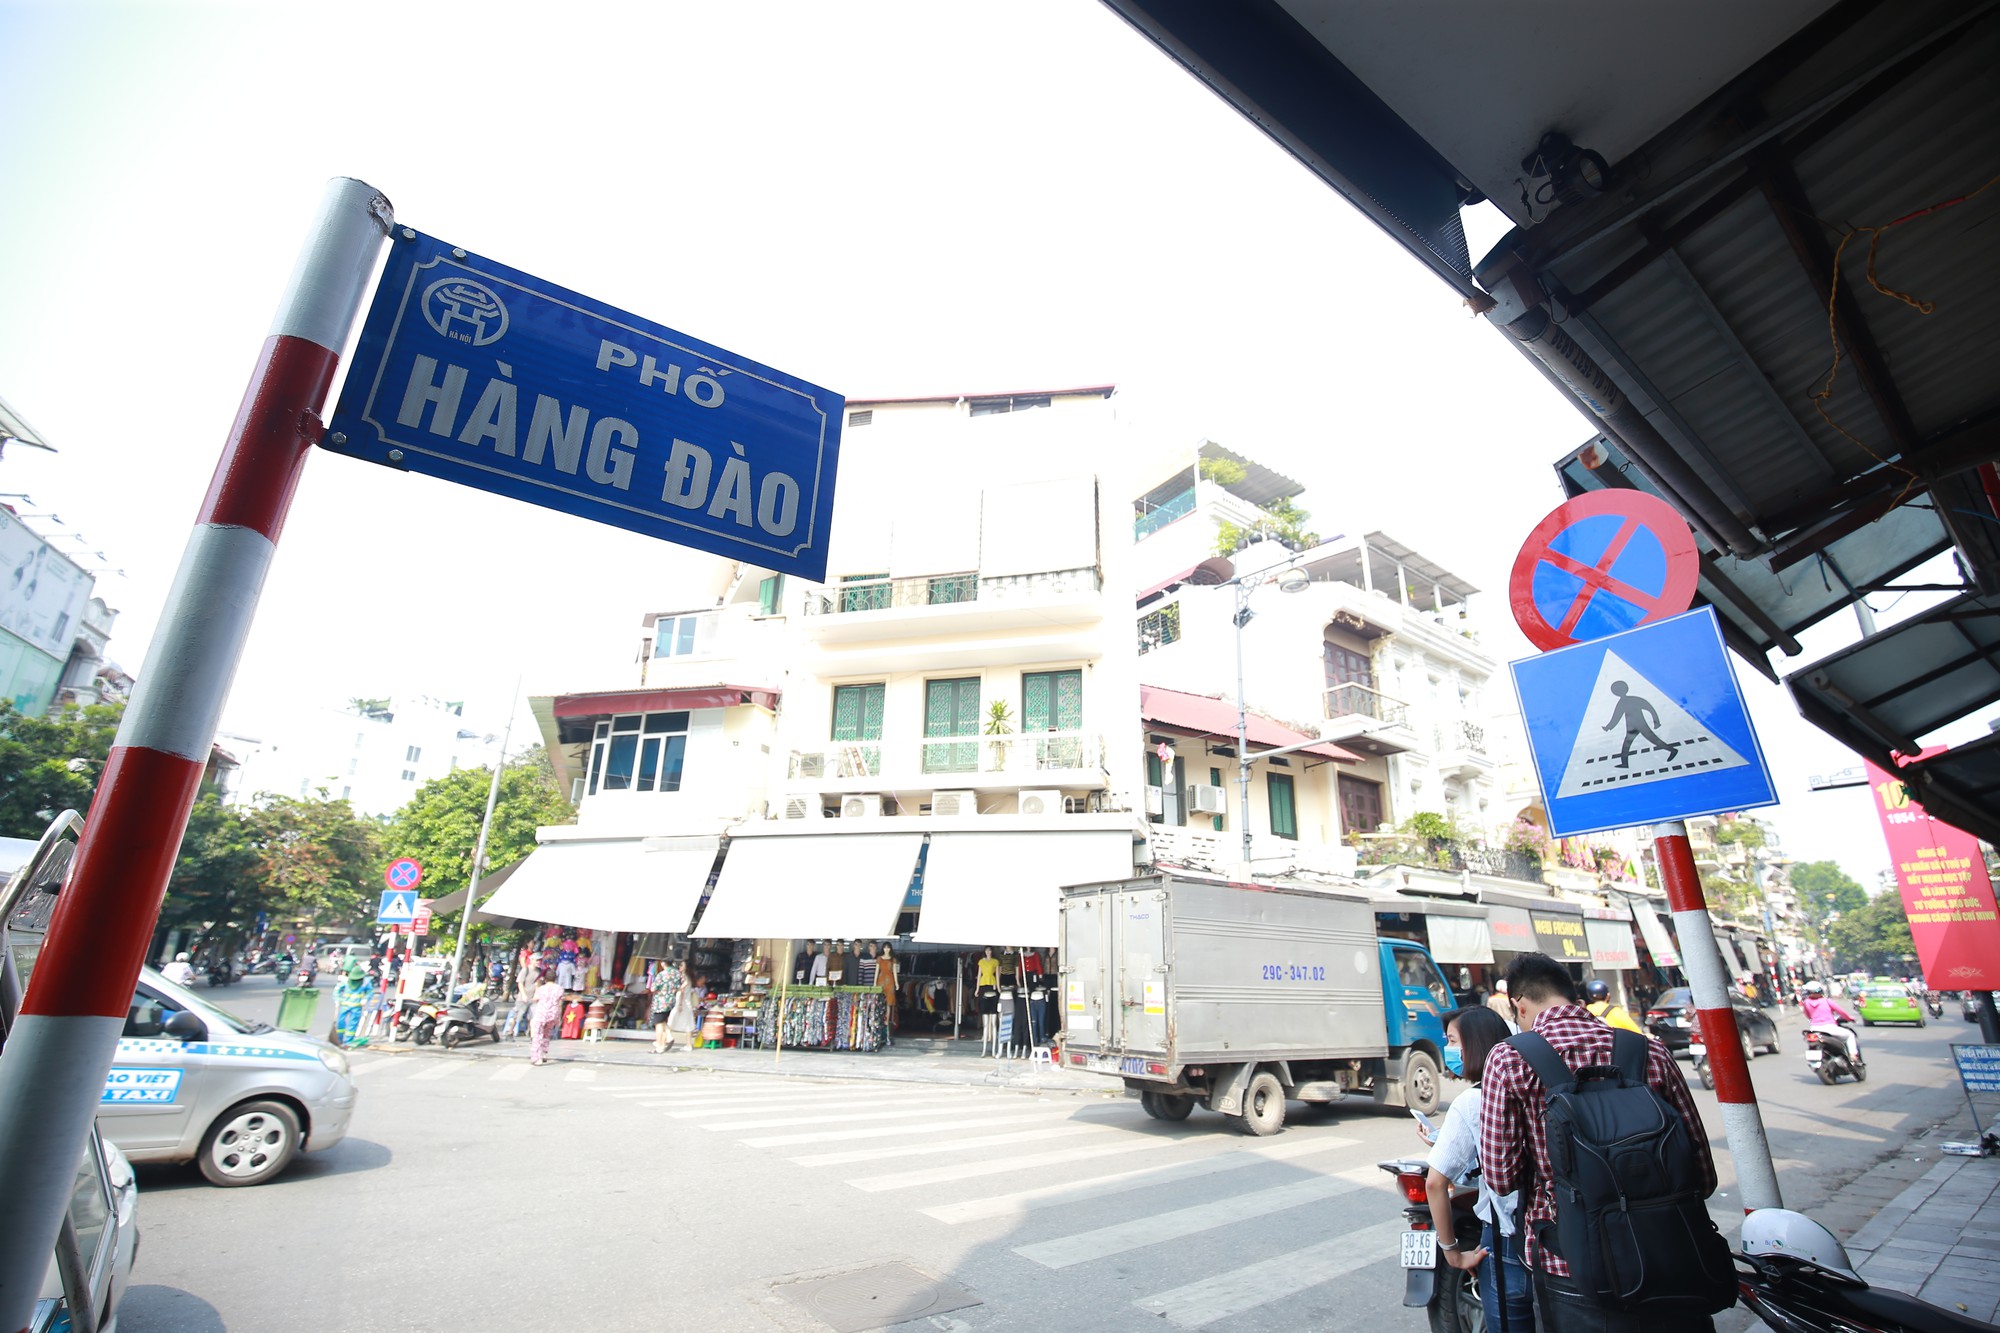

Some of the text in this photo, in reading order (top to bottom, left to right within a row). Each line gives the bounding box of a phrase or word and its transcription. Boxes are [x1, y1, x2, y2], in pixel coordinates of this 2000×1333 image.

[448, 330, 471, 345] HÀ NỘI
[596, 338, 732, 409] PHỐ
[396, 354, 800, 538] HÀNG ĐÀO
[1887, 812, 1916, 824] 1954
[136, 1072, 171, 1087] VIỆT
[111, 1090, 172, 1100] TAXI
[1405, 1233, 1430, 1248] 30-K6
[1405, 1250, 1430, 1265] 6202
